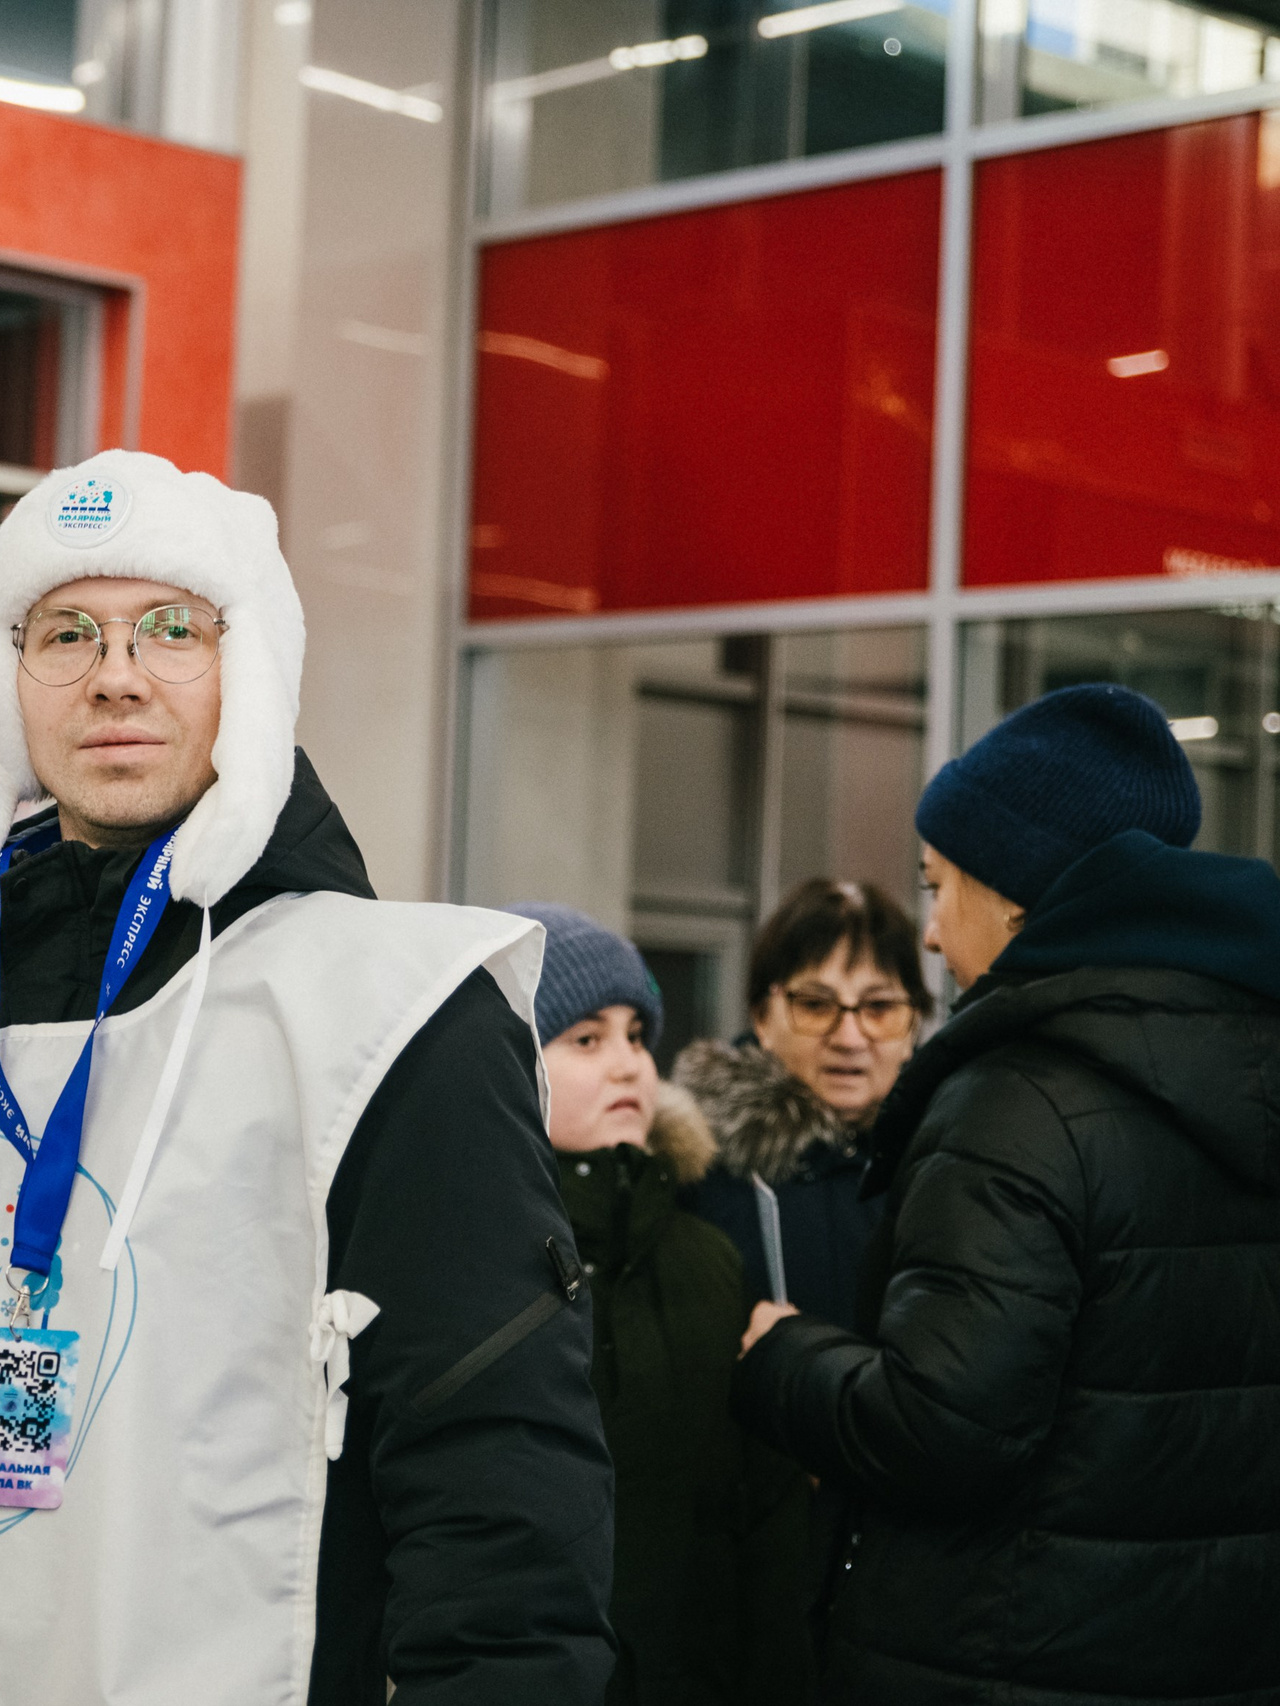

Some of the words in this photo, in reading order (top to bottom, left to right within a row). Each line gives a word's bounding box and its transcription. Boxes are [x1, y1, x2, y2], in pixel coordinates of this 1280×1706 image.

[58, 513, 111, 522] ПОЛЯРНЫЙ
[116, 894, 152, 969] ЭКСПРЕСС
[16, 1479, 33, 1490] ВК
